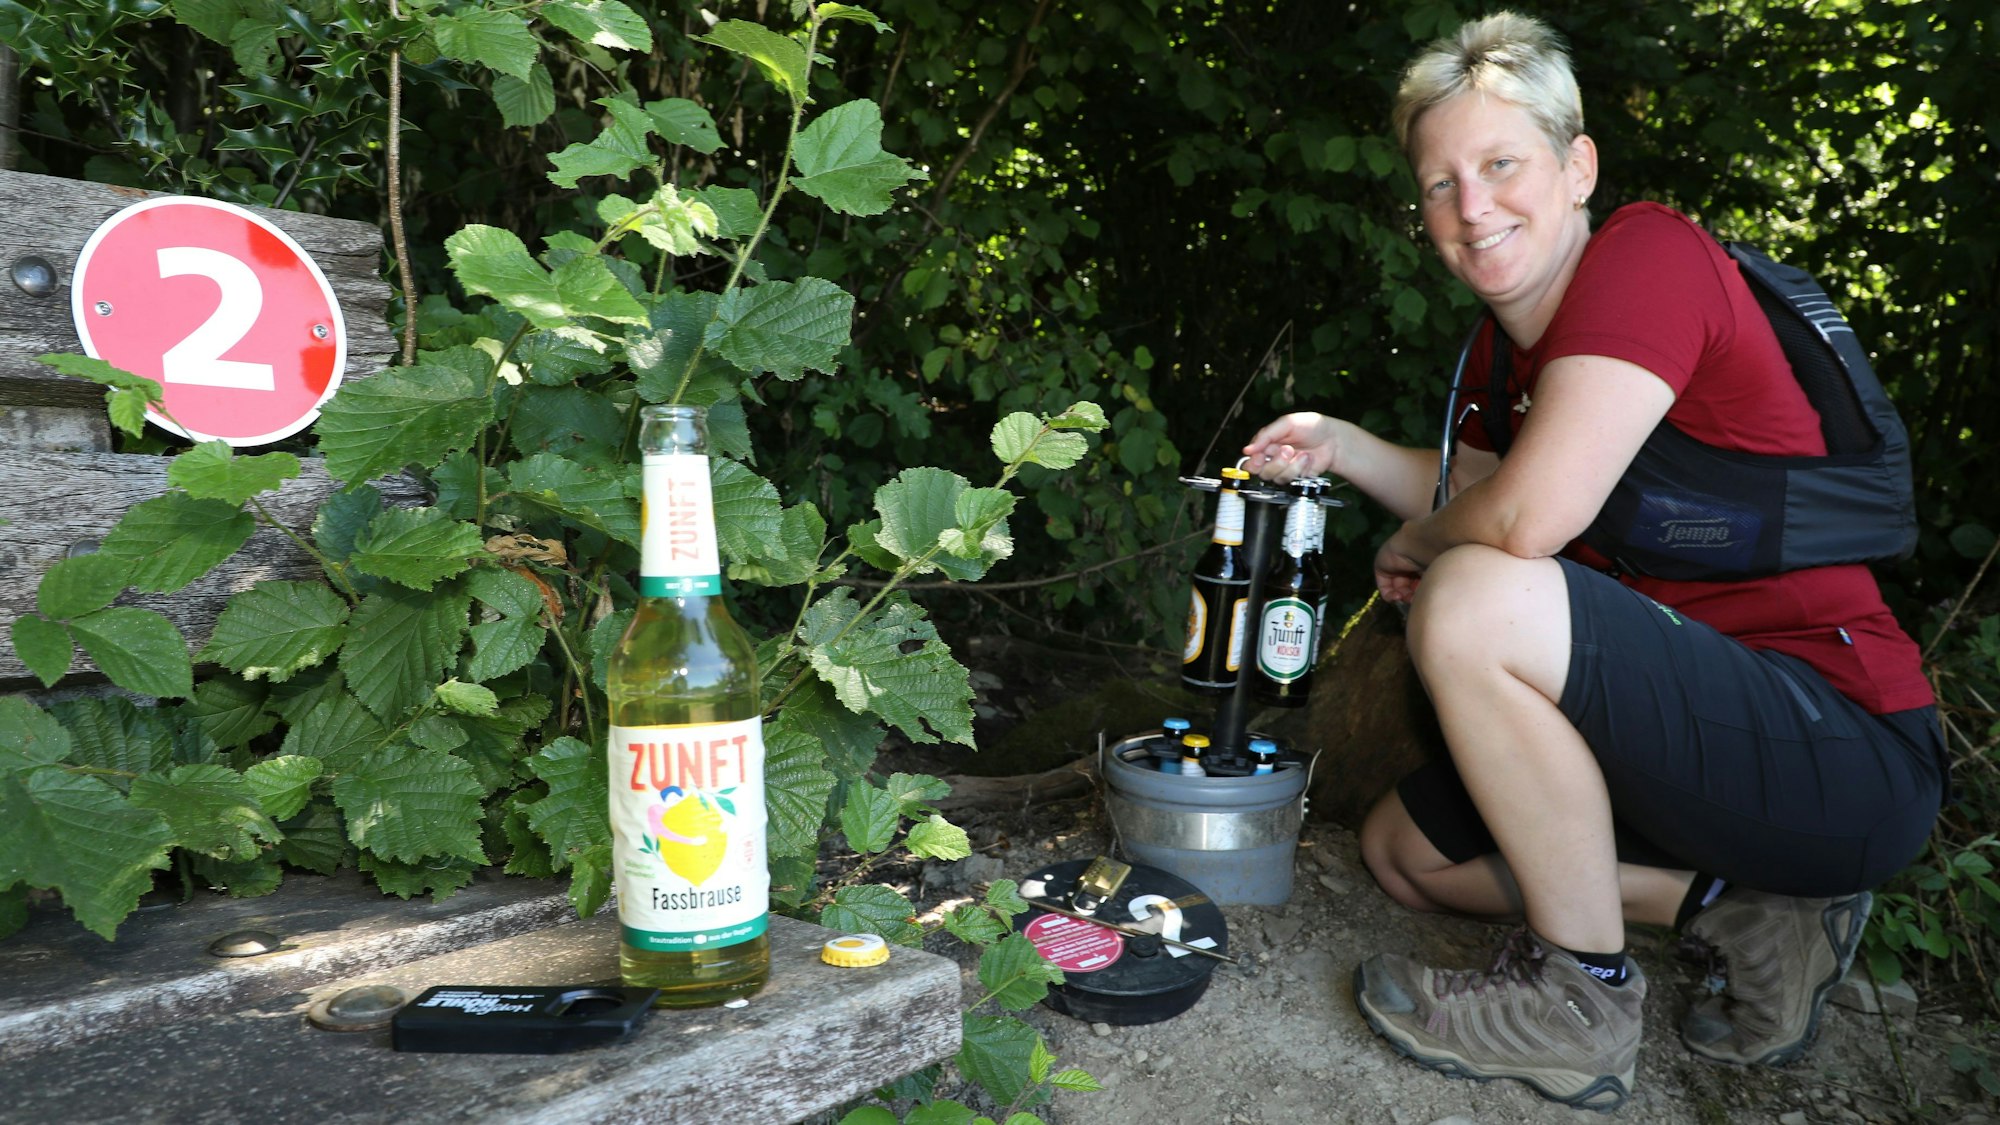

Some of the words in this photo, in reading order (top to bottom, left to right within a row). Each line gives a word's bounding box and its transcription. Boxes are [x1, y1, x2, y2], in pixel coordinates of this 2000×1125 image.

[157, 247, 275, 391] 2
[668, 478, 699, 560] ZUNFT
[628, 735, 748, 792] ZUNFT
[653, 885, 742, 910] Fassbrause
